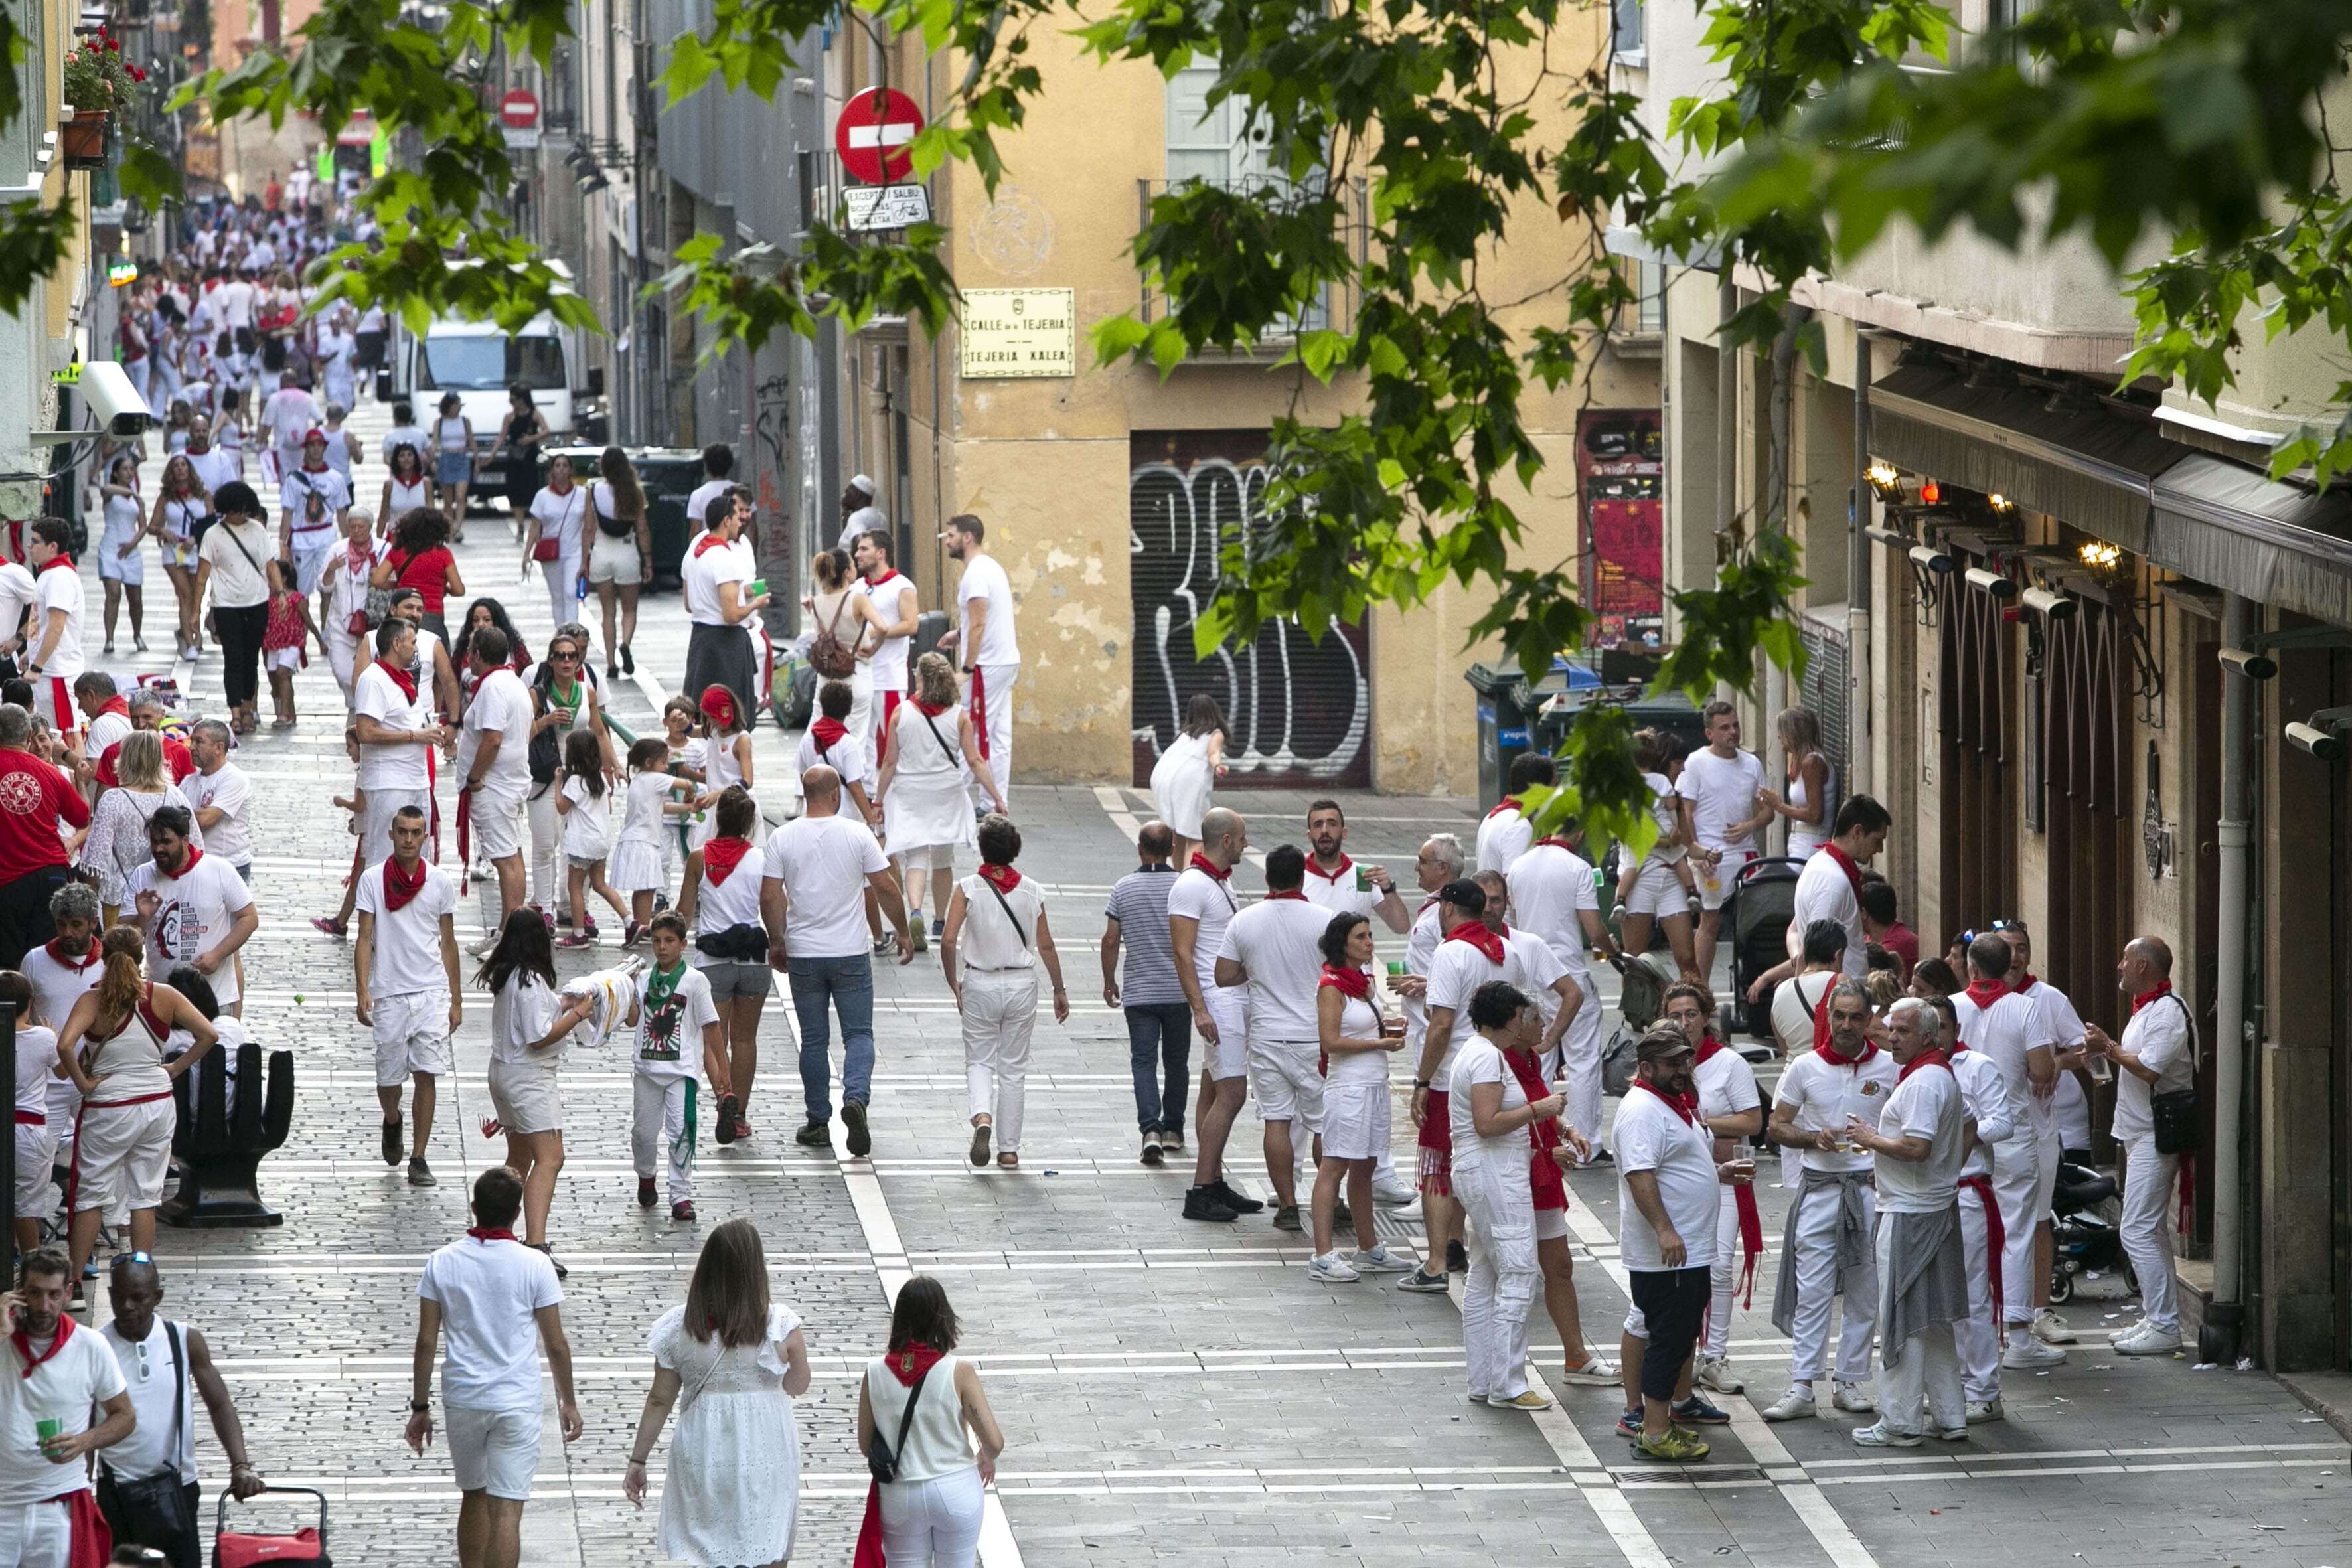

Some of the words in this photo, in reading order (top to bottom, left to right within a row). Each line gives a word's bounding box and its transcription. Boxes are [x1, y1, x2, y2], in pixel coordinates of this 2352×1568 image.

[849, 191, 885, 200] EXCEPTO
[971, 320, 1002, 330] CALLE
[1024, 319, 1065, 329] TEJERIA
[971, 351, 1018, 362] TEJERIA
[1030, 351, 1065, 361] KALEA
[1, 774, 19, 796] JESUS
[23, 775, 40, 796] MARI
